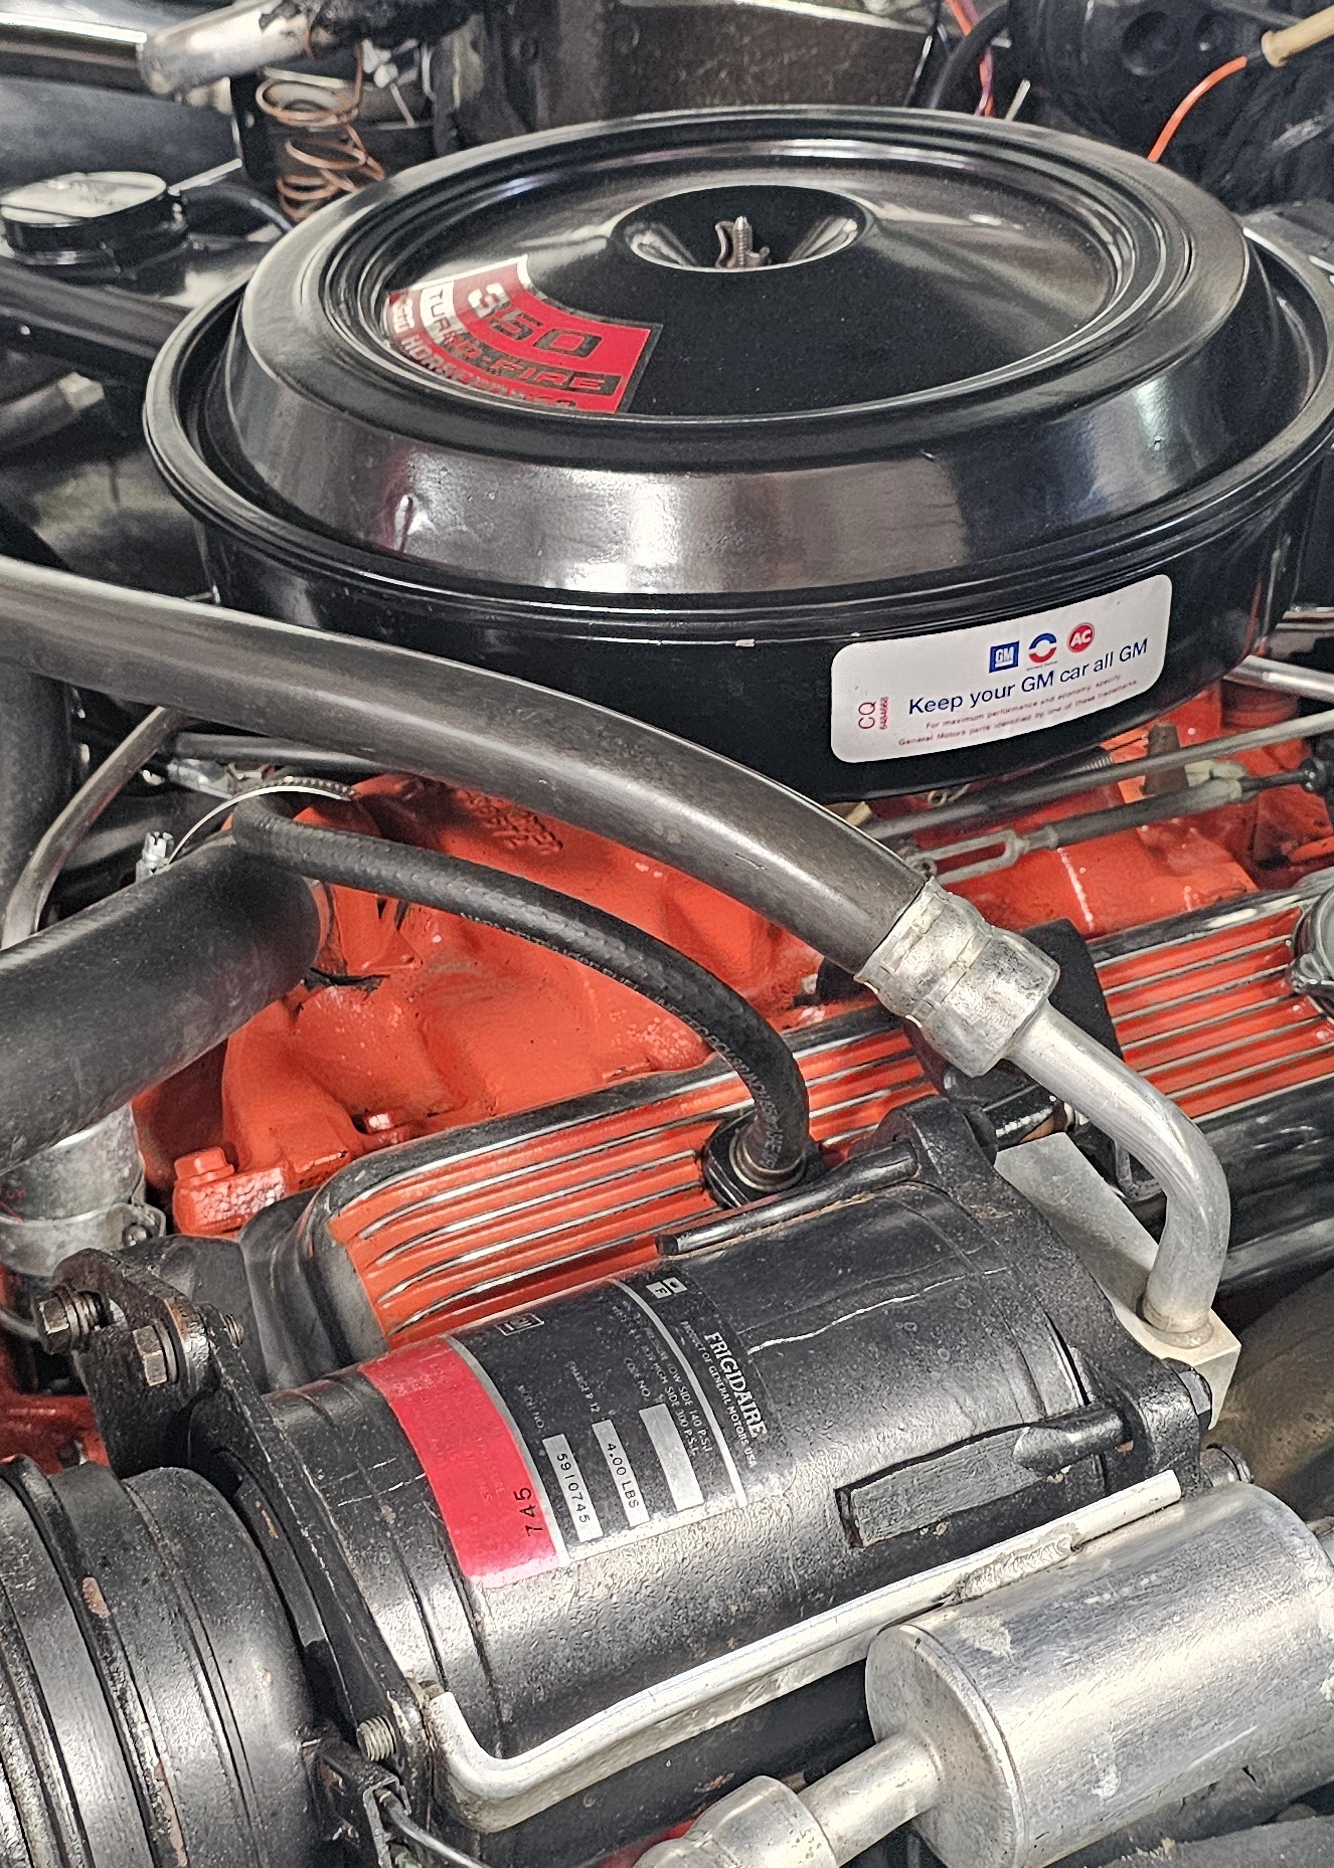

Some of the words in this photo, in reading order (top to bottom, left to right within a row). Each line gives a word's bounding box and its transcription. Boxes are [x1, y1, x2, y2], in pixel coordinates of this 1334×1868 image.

[468, 282, 604, 359] 350
[993, 644, 1016, 669] GM
[1069, 627, 1093, 649] AC
[909, 695, 963, 715] Keep
[970, 684, 1016, 709] your
[1021, 670, 1055, 693] GM
[1060, 663, 1090, 683] car
[1093, 651, 1114, 673] all
[1119, 637, 1149, 662] GM
[942, 714, 984, 725] maximum
[987, 702, 1038, 719] performance
[1041, 696, 1055, 706] and
[1096, 674, 1121, 688] specify
[858, 701, 877, 730] CQ
[898, 735, 934, 746] General
[937, 730, 966, 740] Motors
[969, 724, 991, 735] parts
[994, 715, 1032, 729] identified
[653, 1362, 668, 1384] HIGH
[665, 1386, 680, 1407] SIDE
[675, 1409, 689, 1428] 300
[668, 1363, 683, 1384] LOW
[678, 1385, 694, 1406] SIDE
[689, 1409, 703, 1427] 140
[680, 1320, 707, 1353] PRODUCT
[708, 1365, 732, 1406] GENERAL
[727, 1405, 750, 1445] MOTORS
[744, 1447, 758, 1468] USA
[704, 1331, 768, 1439] FRIGIDAIRE
[556, 1452, 591, 1524] 5910745
[606, 1443, 627, 1476] 4.00
[621, 1480, 640, 1509] LBS
[513, 1487, 544, 1537] 745
